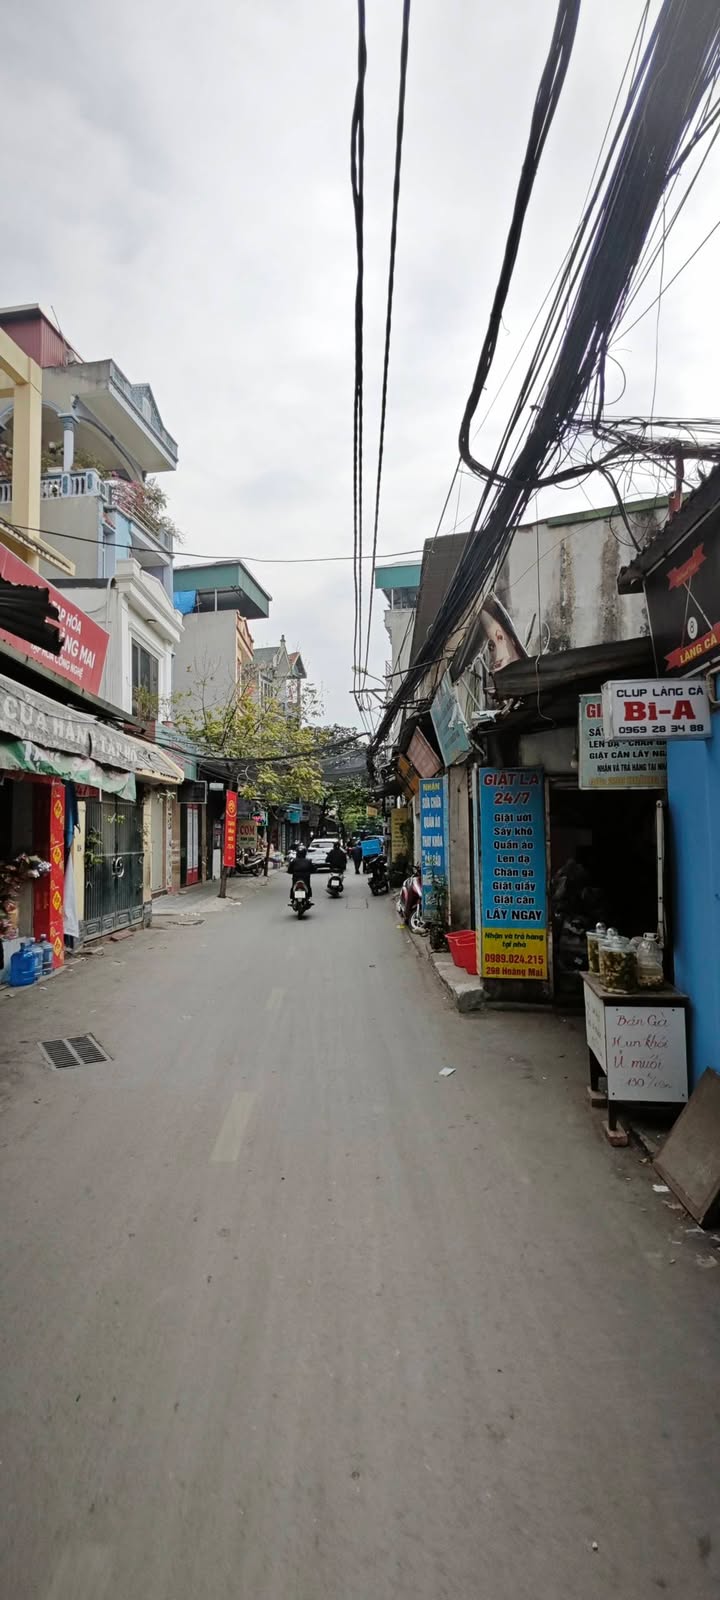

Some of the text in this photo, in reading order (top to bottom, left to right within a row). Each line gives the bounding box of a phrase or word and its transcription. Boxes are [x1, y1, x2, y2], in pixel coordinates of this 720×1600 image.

[66, 613, 82, 634] HÓA
[80, 644, 95, 669] MAI
[616, 688, 648, 698] CLUP
[624, 700, 696, 721] Bi-A
[618, 724, 704, 734] 0969 28 34 88
[494, 791, 530, 805] 24/7
[497, 854, 514, 863] Len
[511, 910, 542, 921] NGAY
